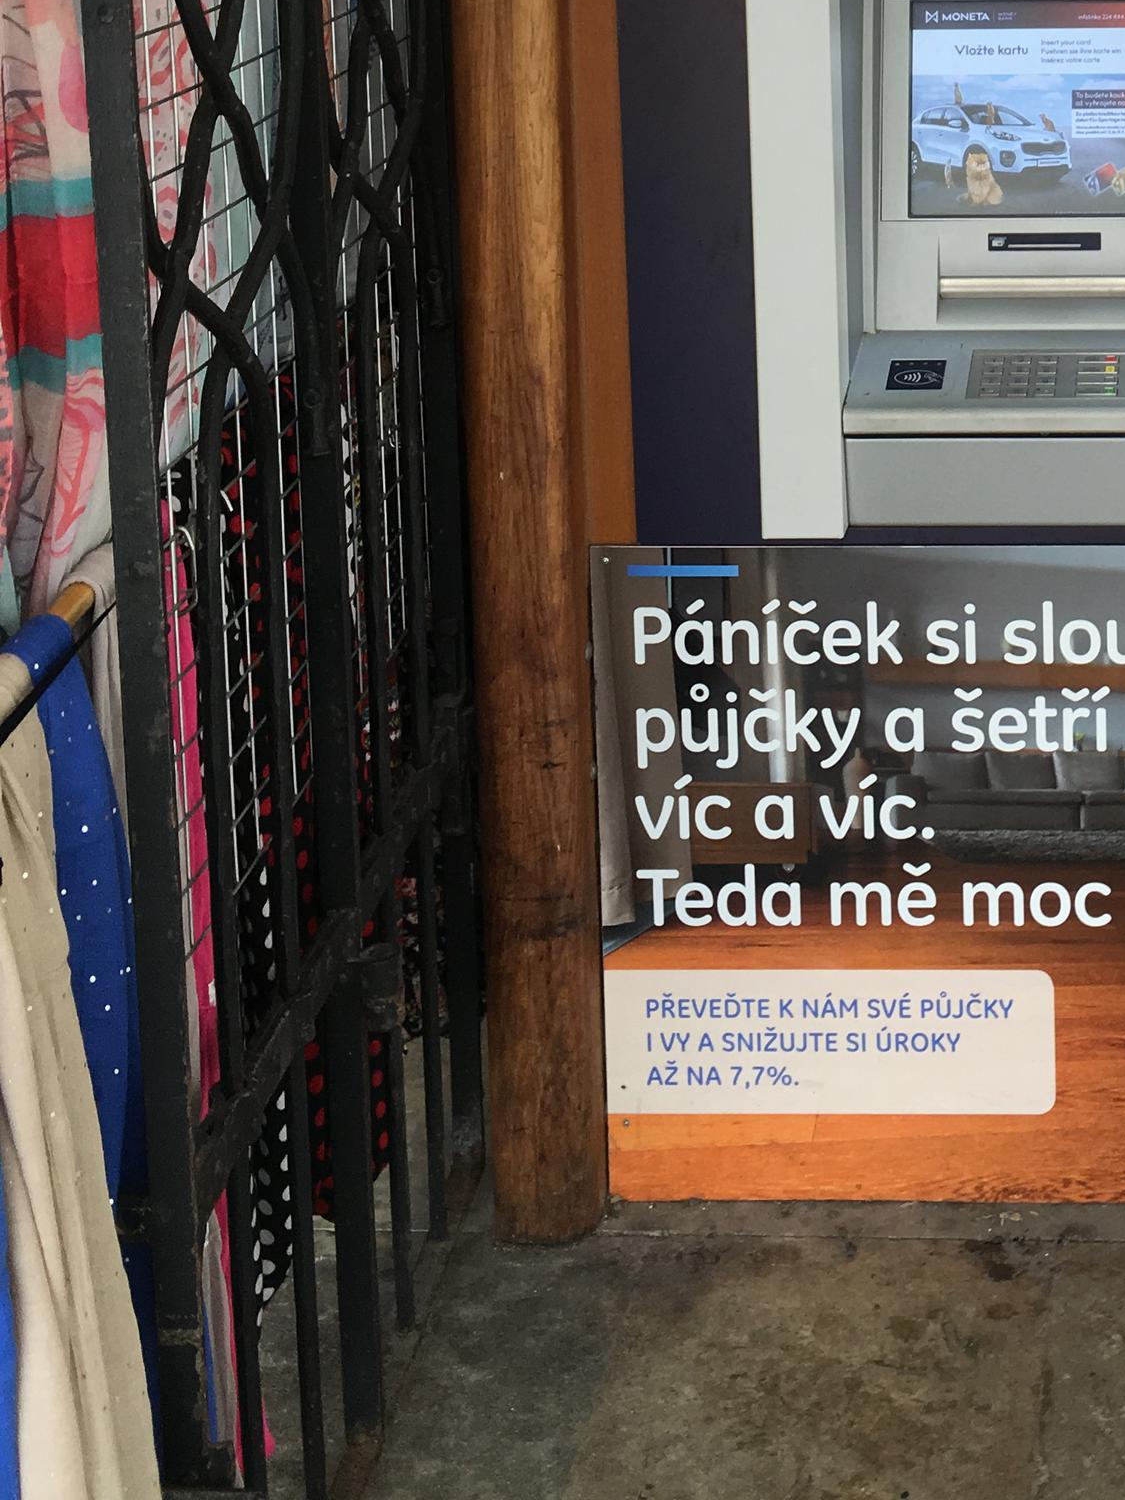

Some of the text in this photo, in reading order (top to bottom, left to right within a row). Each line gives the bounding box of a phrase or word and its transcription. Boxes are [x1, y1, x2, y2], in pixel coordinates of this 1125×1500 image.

[942, 11, 990, 21] MONETA
[954, 44, 1029, 56] Vložte kartu
[632, 598, 903, 666] Páníček
[925, 602, 977, 665] si
[636, 682, 1110, 770] půjčky a šetří
[633, 774, 936, 841] víc a víc.
[636, 864, 801, 928] Teda
[829, 862, 937, 928] mě
[962, 879, 1112, 928] moc
[645, 991, 1015, 1021] PŘEVEĎTE K NÁM SVÉ PŮJČKY
[646, 1025, 962, 1053] I VY A SNIŽUJTE SI ÚROKY
[646, 1058, 801, 1088] AŽ NA 7,7%.
